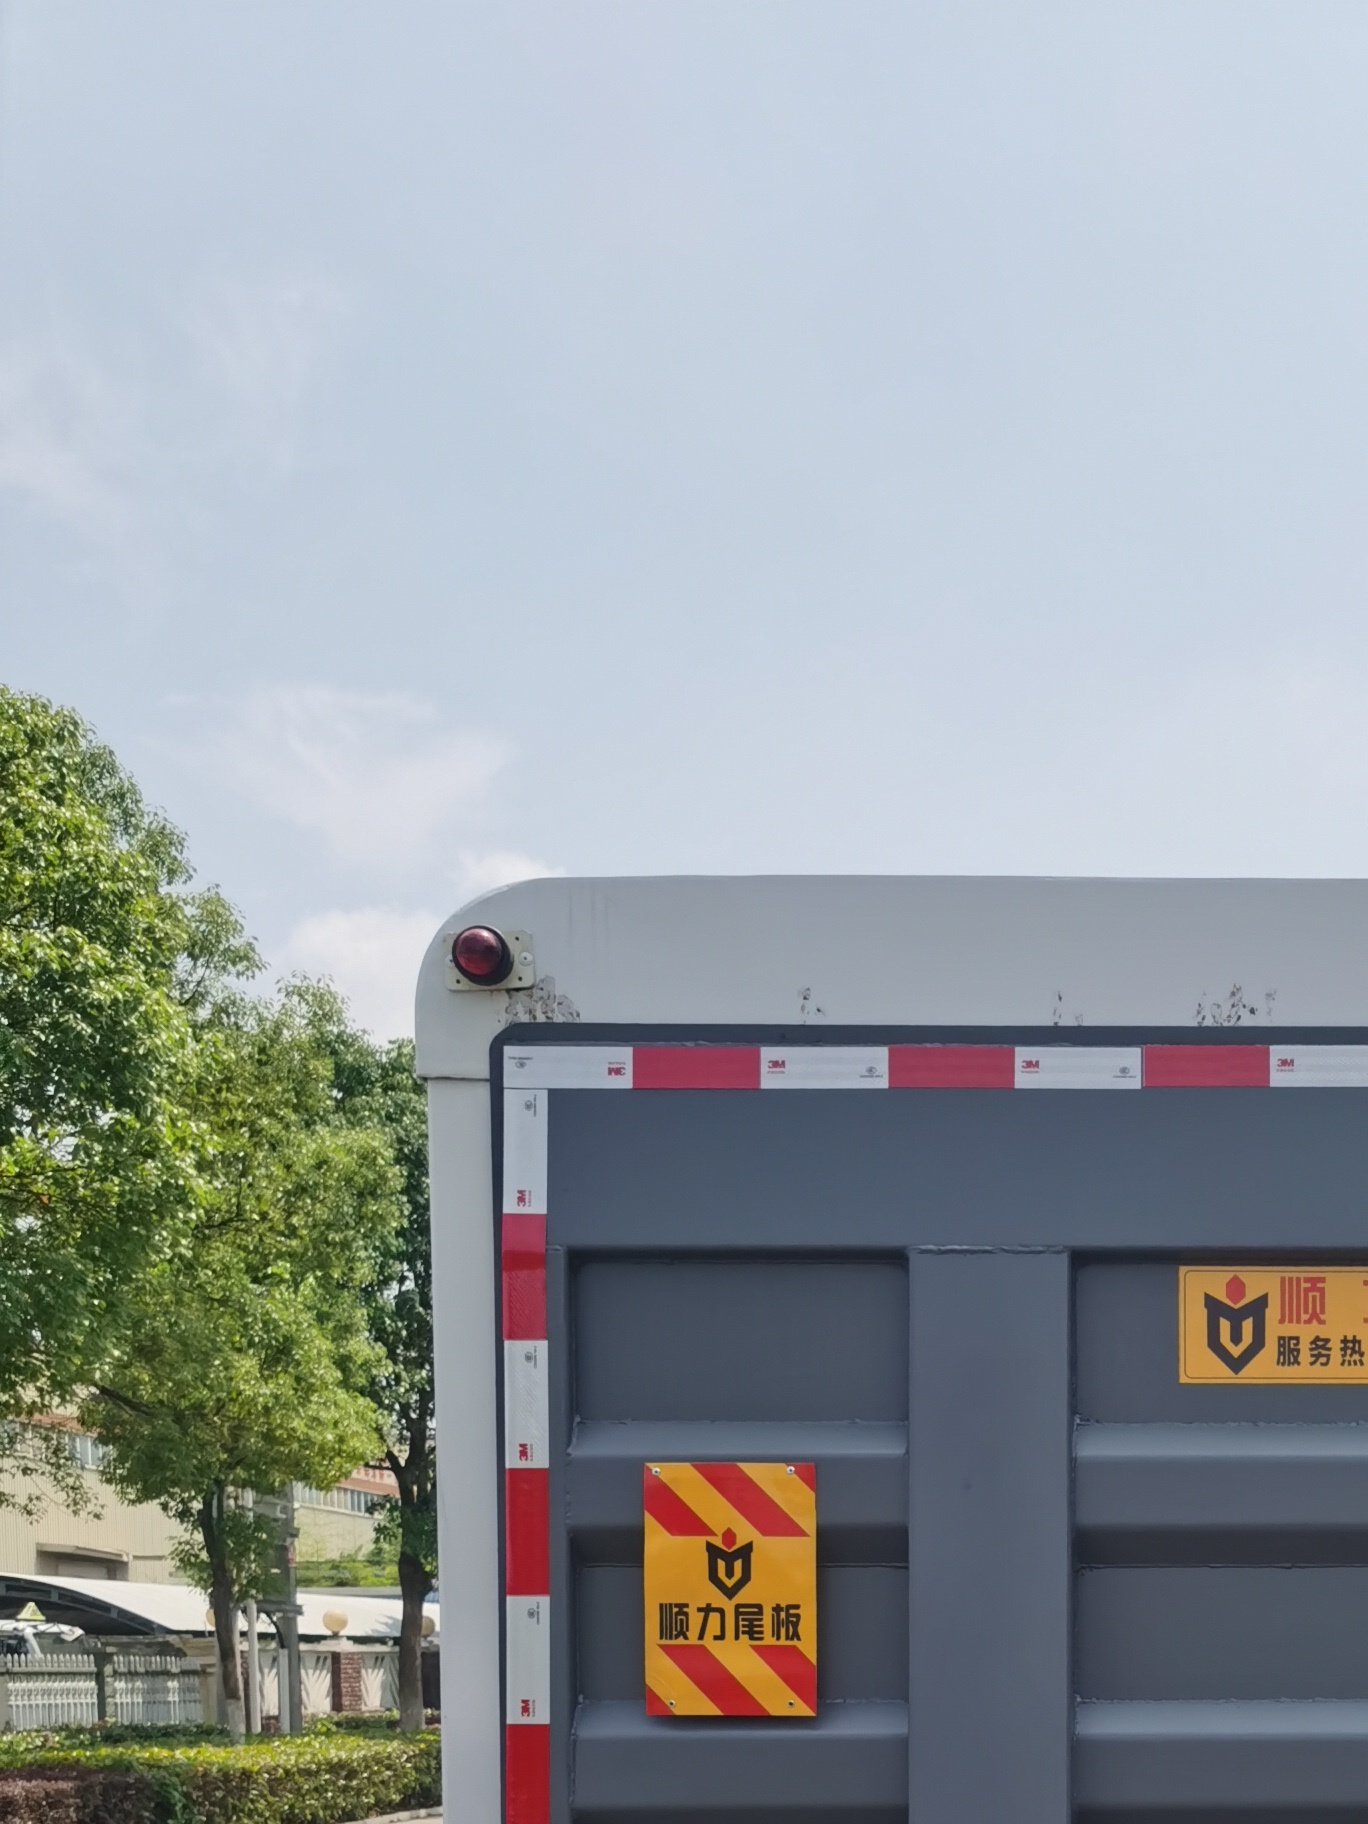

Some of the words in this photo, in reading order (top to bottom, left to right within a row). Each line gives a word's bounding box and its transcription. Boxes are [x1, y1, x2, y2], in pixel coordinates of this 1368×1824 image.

[768, 1060, 785, 1069] 3M
[1022, 1060, 1039, 1069] 3M
[1277, 1059, 1294, 1067] 3M
[608, 1067, 626, 1076] 3M
[517, 1190, 526, 1207] 3M
[519, 1443, 529, 1461] 3M
[658, 1602, 802, 1641] 顺力尾板
[520, 1698, 530, 1717] 3M
